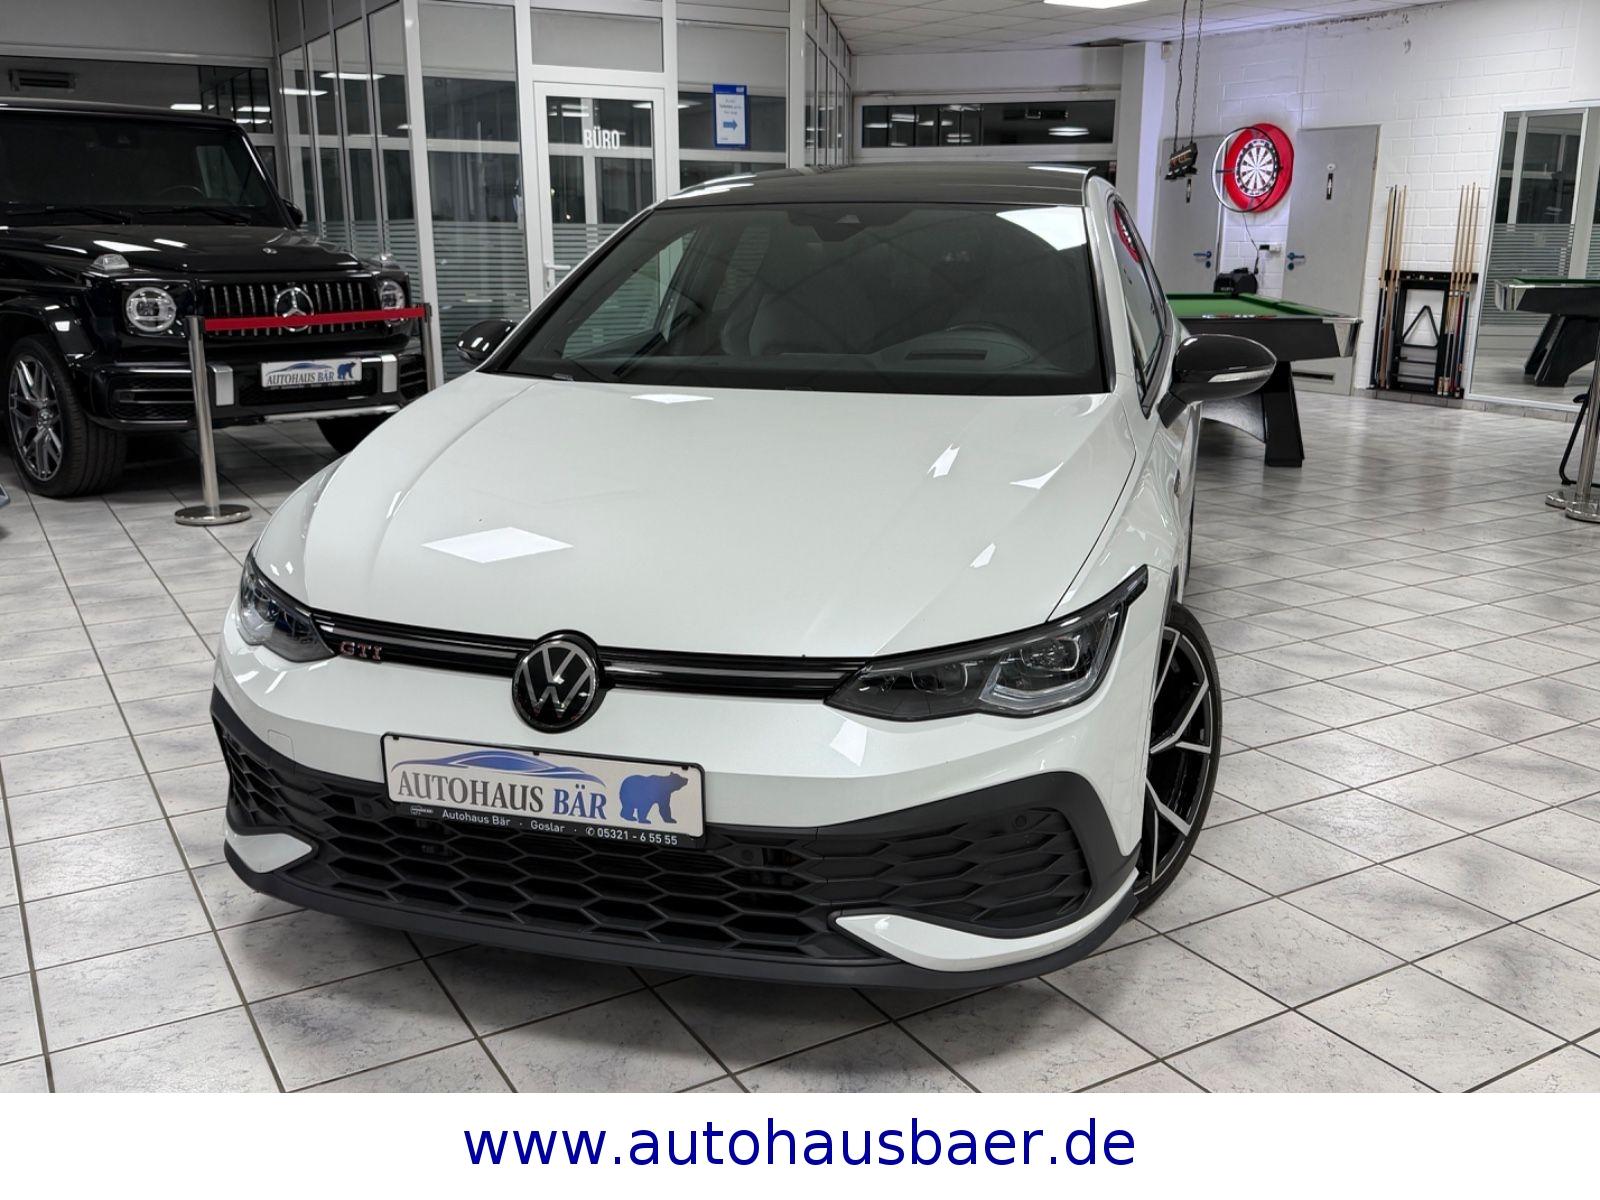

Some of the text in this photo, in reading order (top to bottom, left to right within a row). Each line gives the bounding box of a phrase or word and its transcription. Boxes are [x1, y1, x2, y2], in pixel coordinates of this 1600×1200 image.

[583, 125, 620, 150] BÜRO
[267, 372, 316, 386] AUTOHAUS
[340, 641, 383, 660] GTI
[397, 770, 608, 820] AUTOHAUS BÄR
[441, 809, 490, 825] Autohaus
[492, 815, 511, 826] Bär
[530, 820, 566, 833] Goslar
[597, 827, 629, 840] 05321
[649, 833, 662, 844] 55
[664, 834, 678, 846] 55
